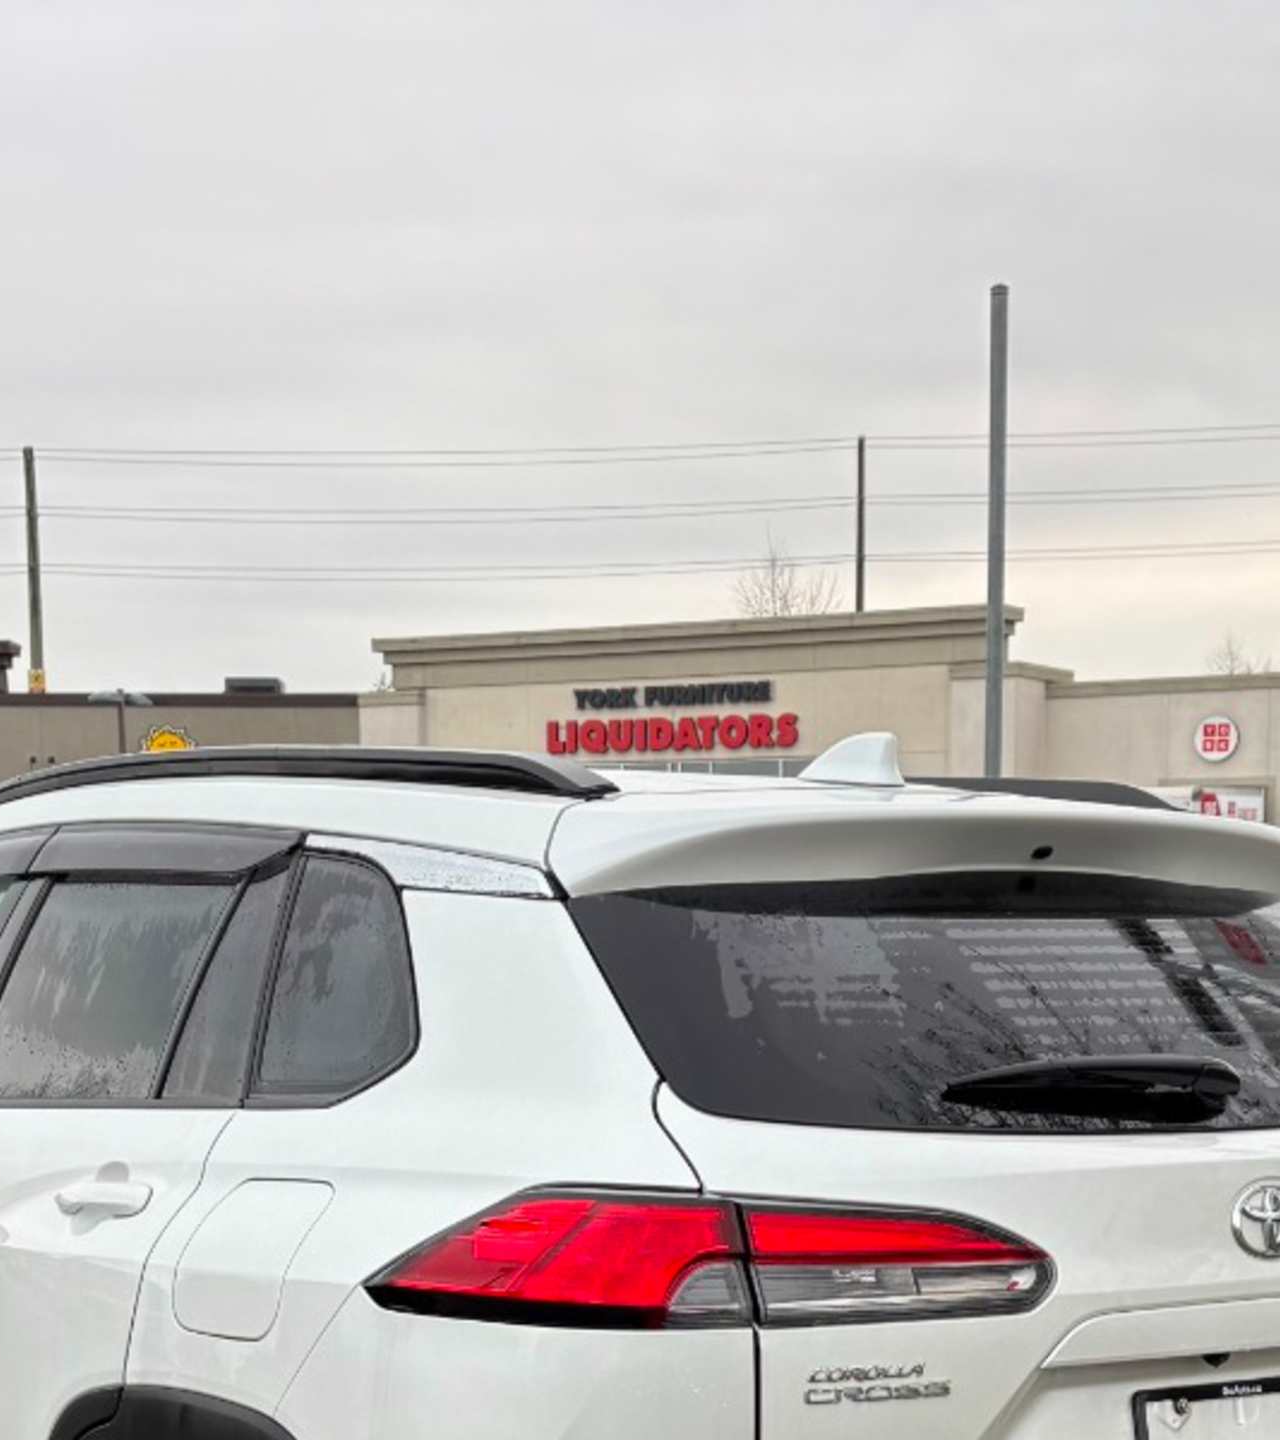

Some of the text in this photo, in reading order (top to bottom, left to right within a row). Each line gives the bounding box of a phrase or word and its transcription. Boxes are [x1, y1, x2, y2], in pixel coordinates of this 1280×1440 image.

[574, 681, 773, 710] YORK FURNITURE
[546, 712, 800, 756] LIQUIDATORS
[808, 1363, 925, 1383] COROLLA
[804, 1381, 952, 1405] CROSS
